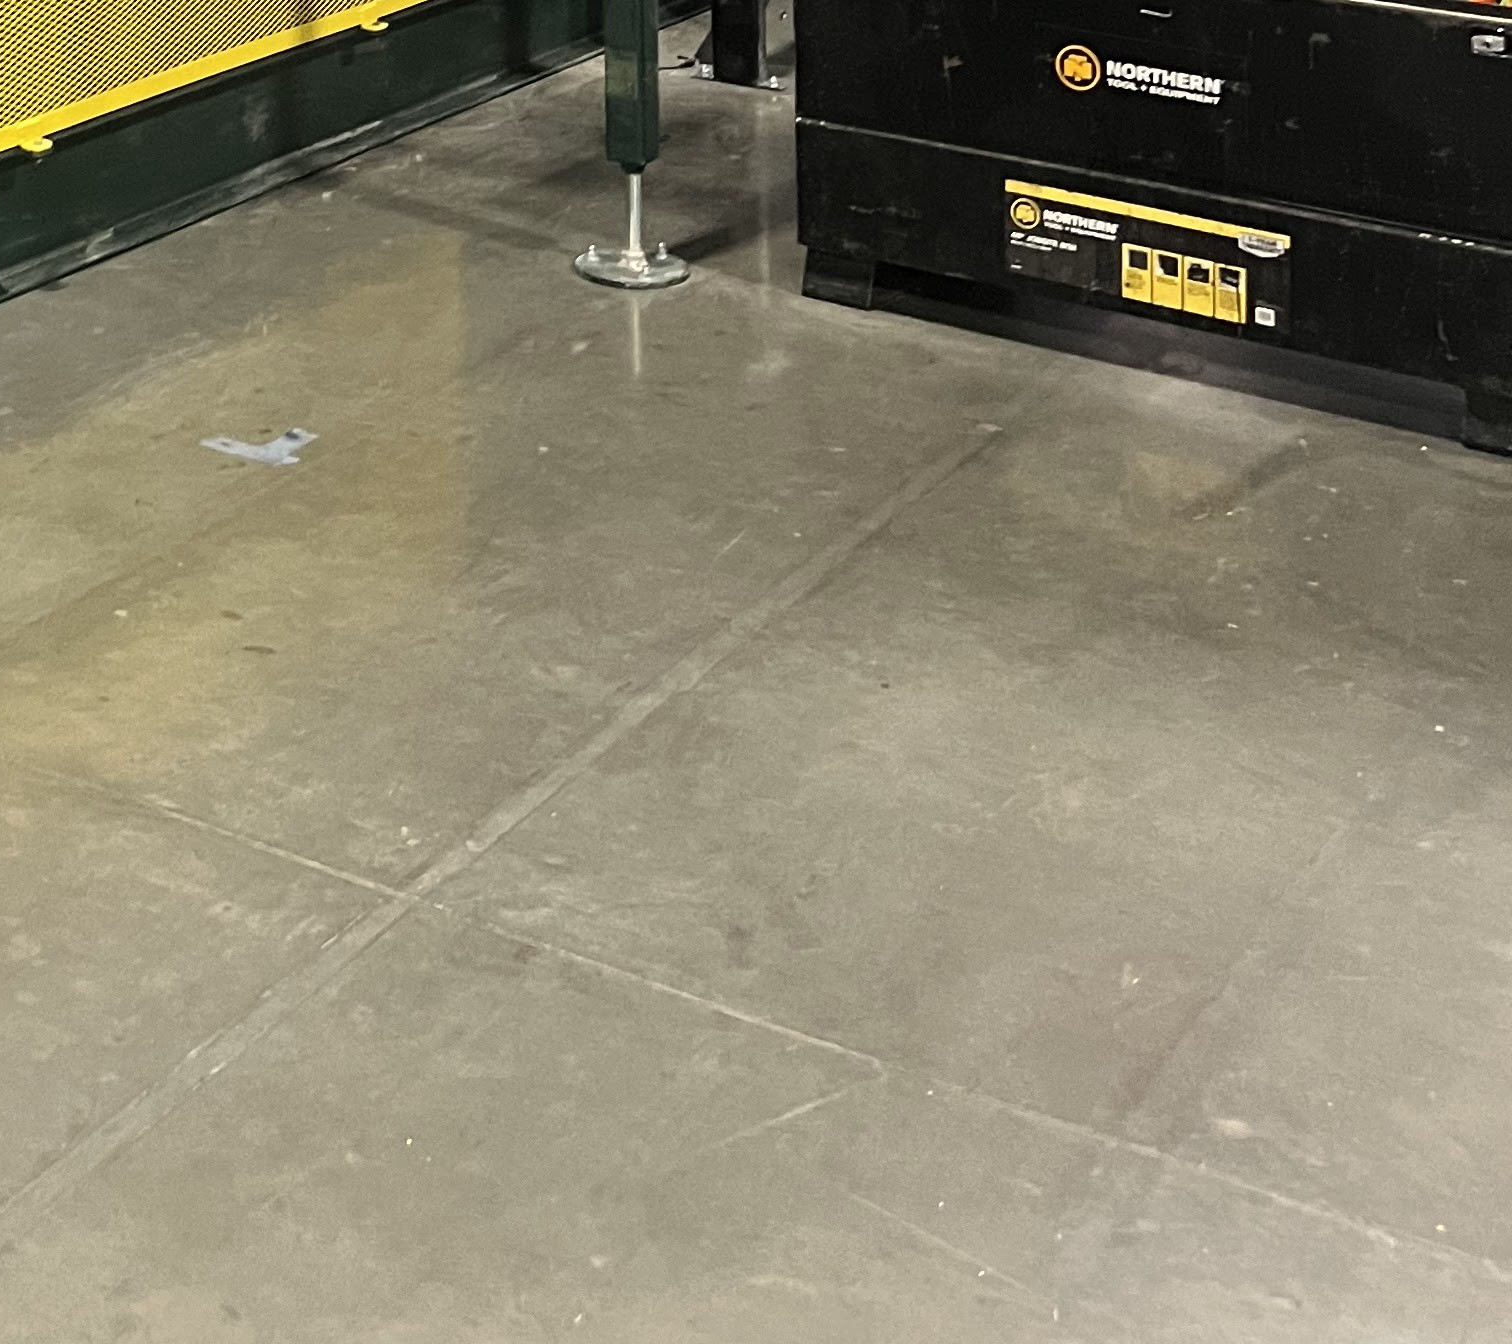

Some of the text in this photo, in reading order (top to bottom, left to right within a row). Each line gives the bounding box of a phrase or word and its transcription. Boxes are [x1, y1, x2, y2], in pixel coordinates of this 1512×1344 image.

[1106, 60, 1223, 95] NORTHERN
[1106, 77, 1138, 91] TOOL
[1149, 85, 1221, 105] EQUIPMENT
[1042, 209, 1119, 234] NORTHERN
